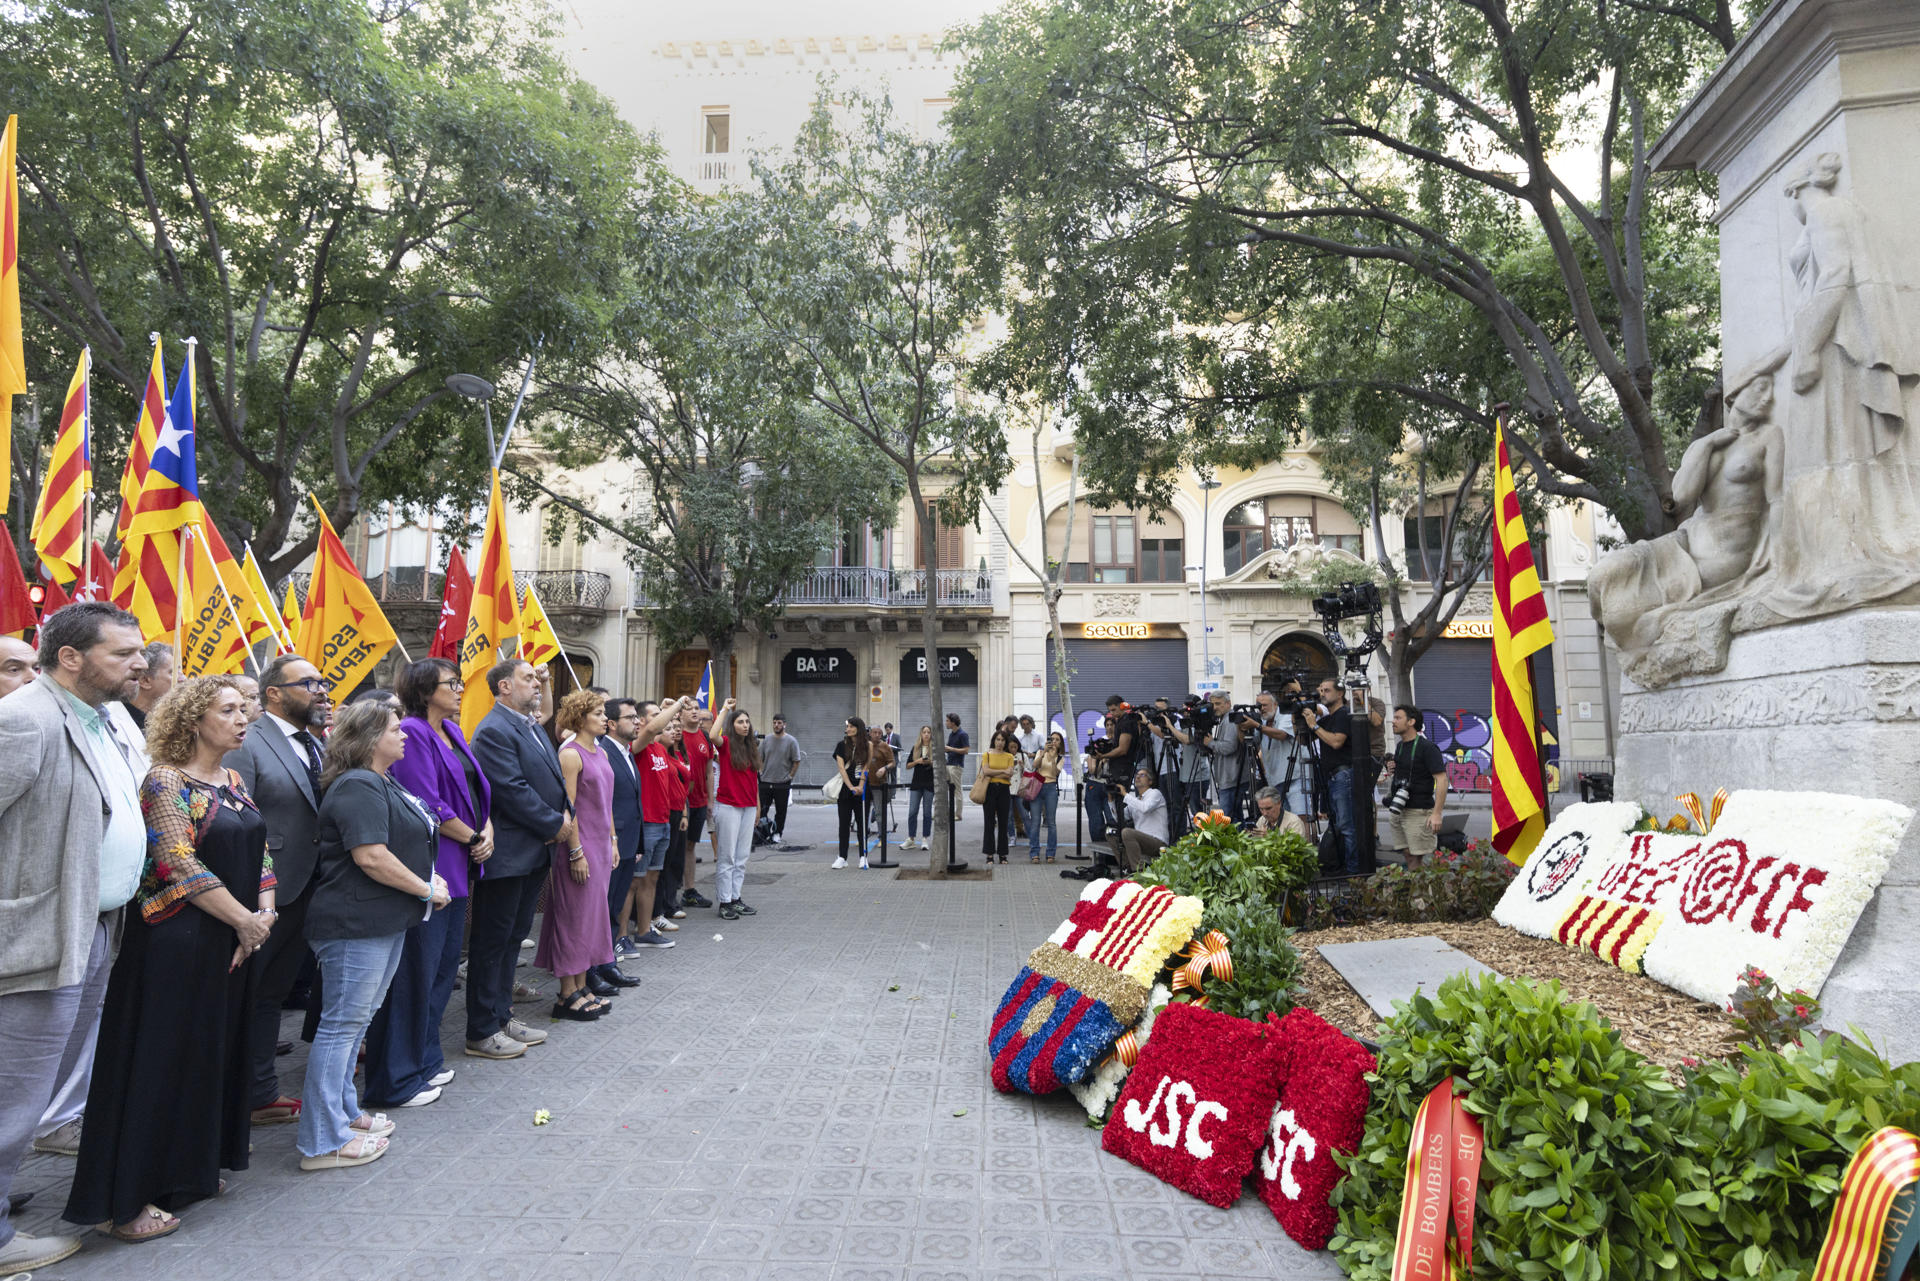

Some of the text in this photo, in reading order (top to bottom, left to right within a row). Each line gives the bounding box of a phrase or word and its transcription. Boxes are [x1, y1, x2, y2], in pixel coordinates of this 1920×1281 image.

[796, 657, 839, 672] BA&P
[916, 656, 960, 672] B&P
[1123, 1075, 1229, 1161] JSC
[1261, 1100, 1318, 1200] SC
[1458, 1133, 1476, 1161] DE
[1414, 1133, 1444, 1278] DE BOMBERS
